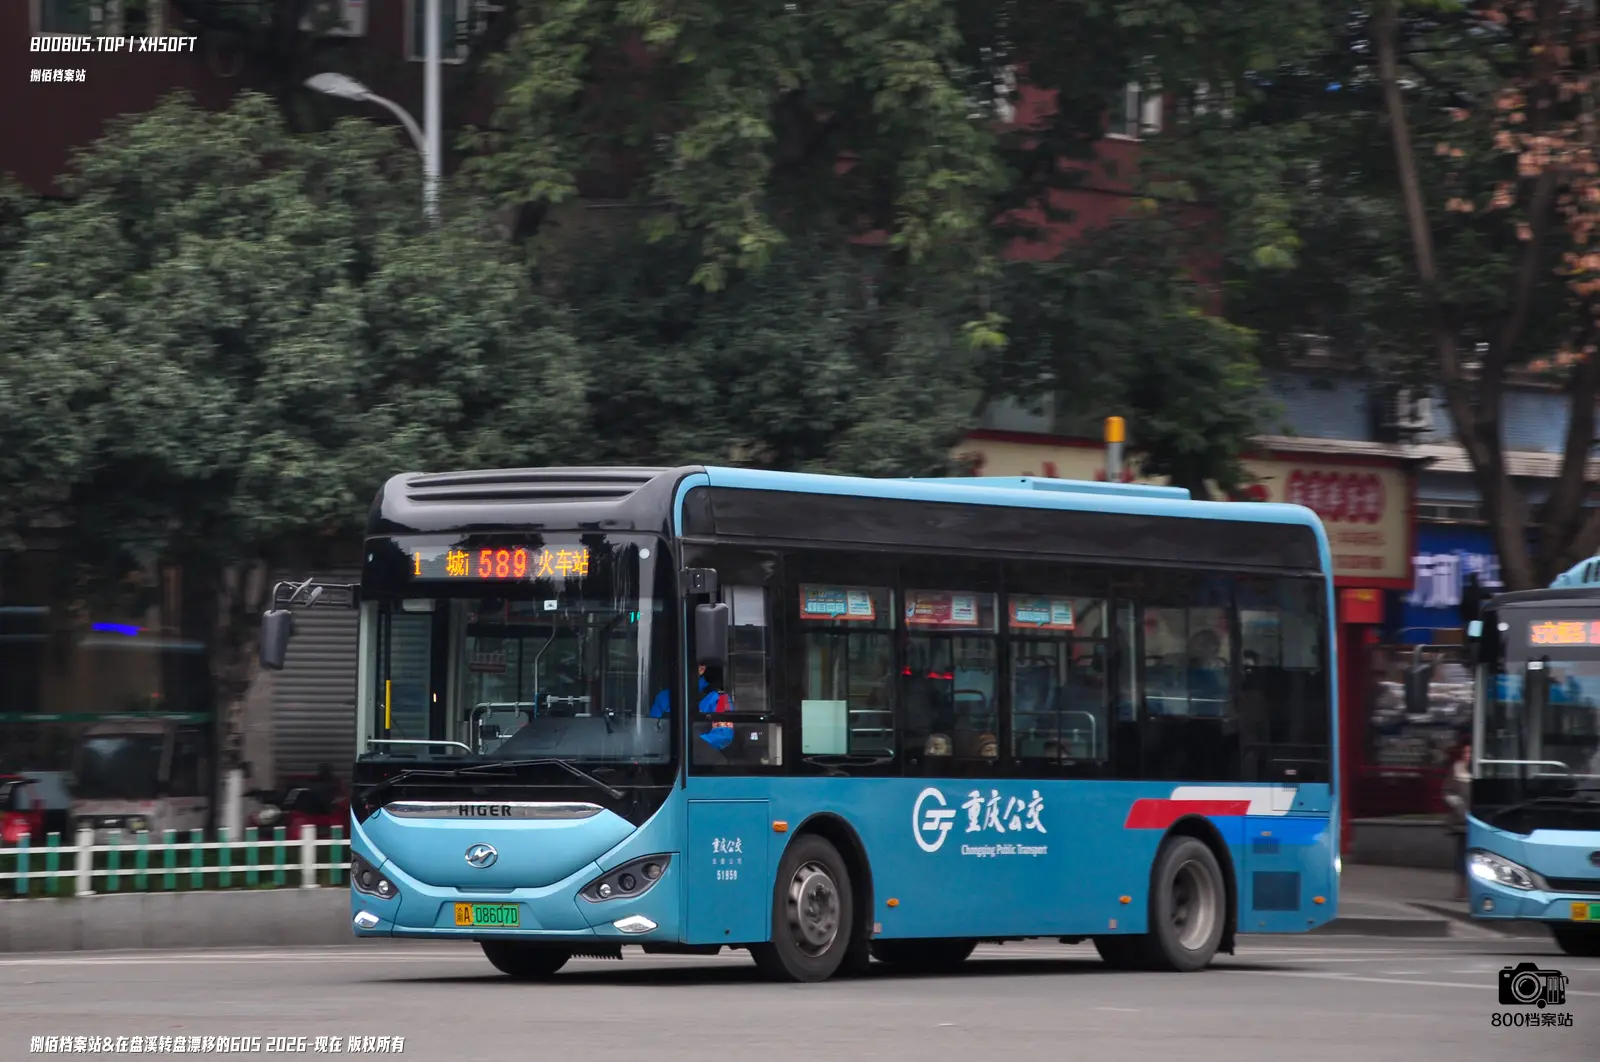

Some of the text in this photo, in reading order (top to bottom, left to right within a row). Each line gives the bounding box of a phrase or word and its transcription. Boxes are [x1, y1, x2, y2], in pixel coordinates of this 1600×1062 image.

[478, 549, 527, 578] 589
[537, 549, 590, 576] 火车站
[459, 804, 512, 817] HIGER
[961, 789, 1048, 834] 重庆公交
[996, 844, 1016, 855] Public
[1017, 844, 1048, 857] Transport
[475, 907, 518, 924] 08607D
